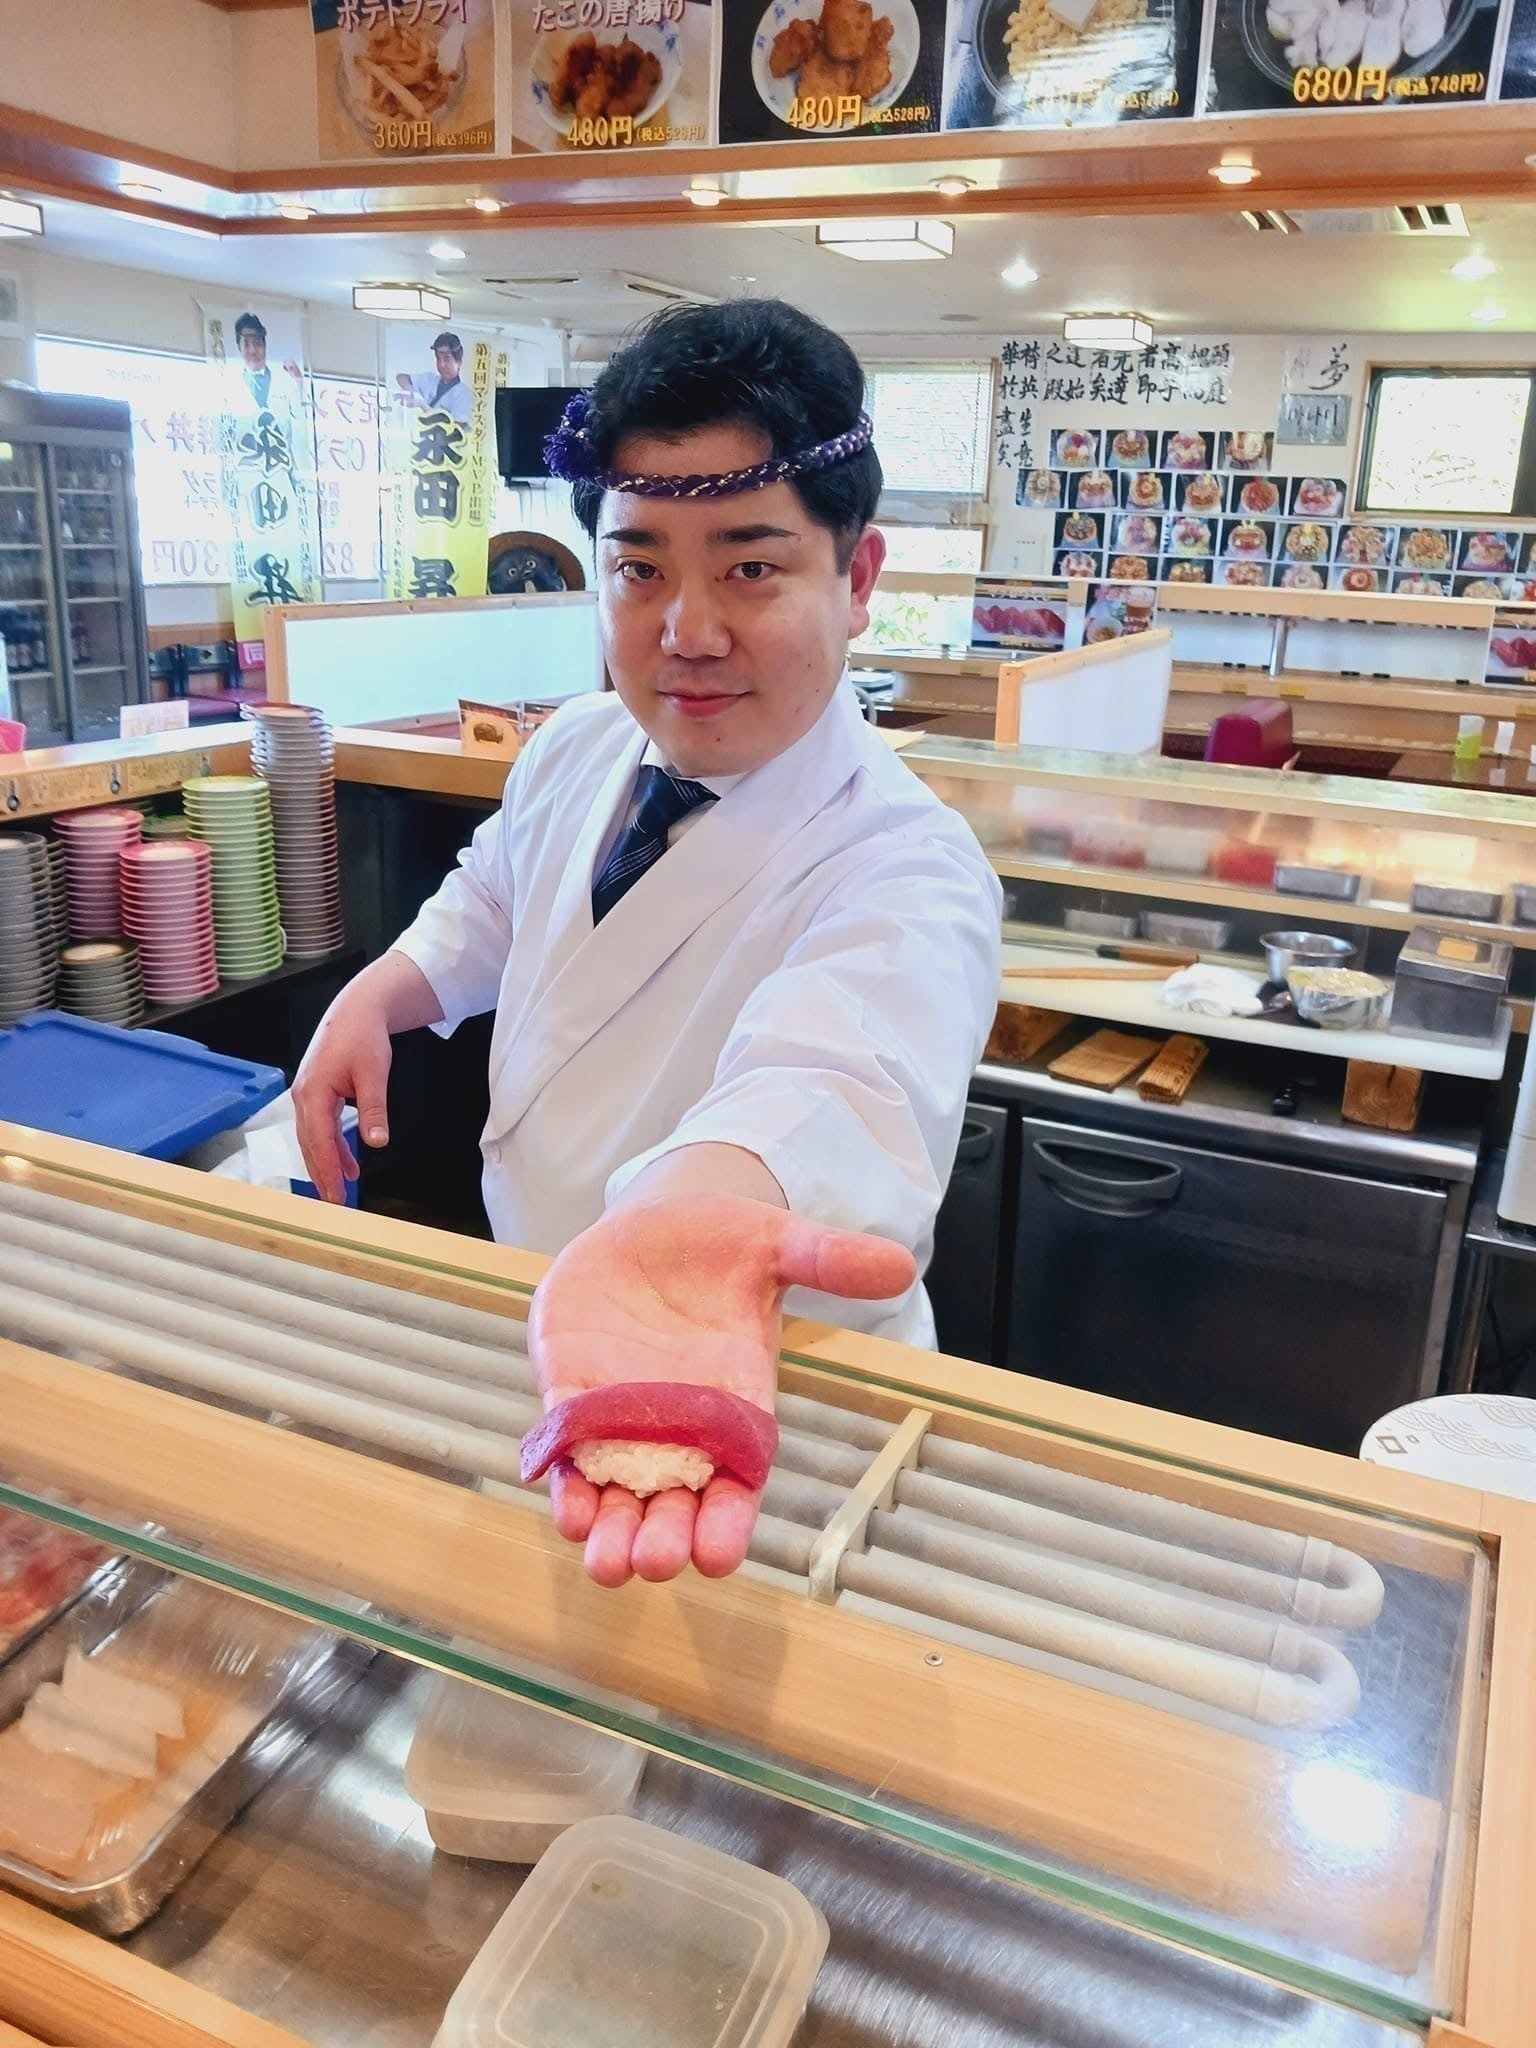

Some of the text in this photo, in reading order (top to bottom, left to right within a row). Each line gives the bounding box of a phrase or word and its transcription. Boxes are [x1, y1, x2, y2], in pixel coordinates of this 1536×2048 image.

[1293, 66, 1387, 102] 680円
[787, 94, 863, 128] 480円
[374, 120, 432, 149] 360円
[566, 115, 633, 147] 480円
